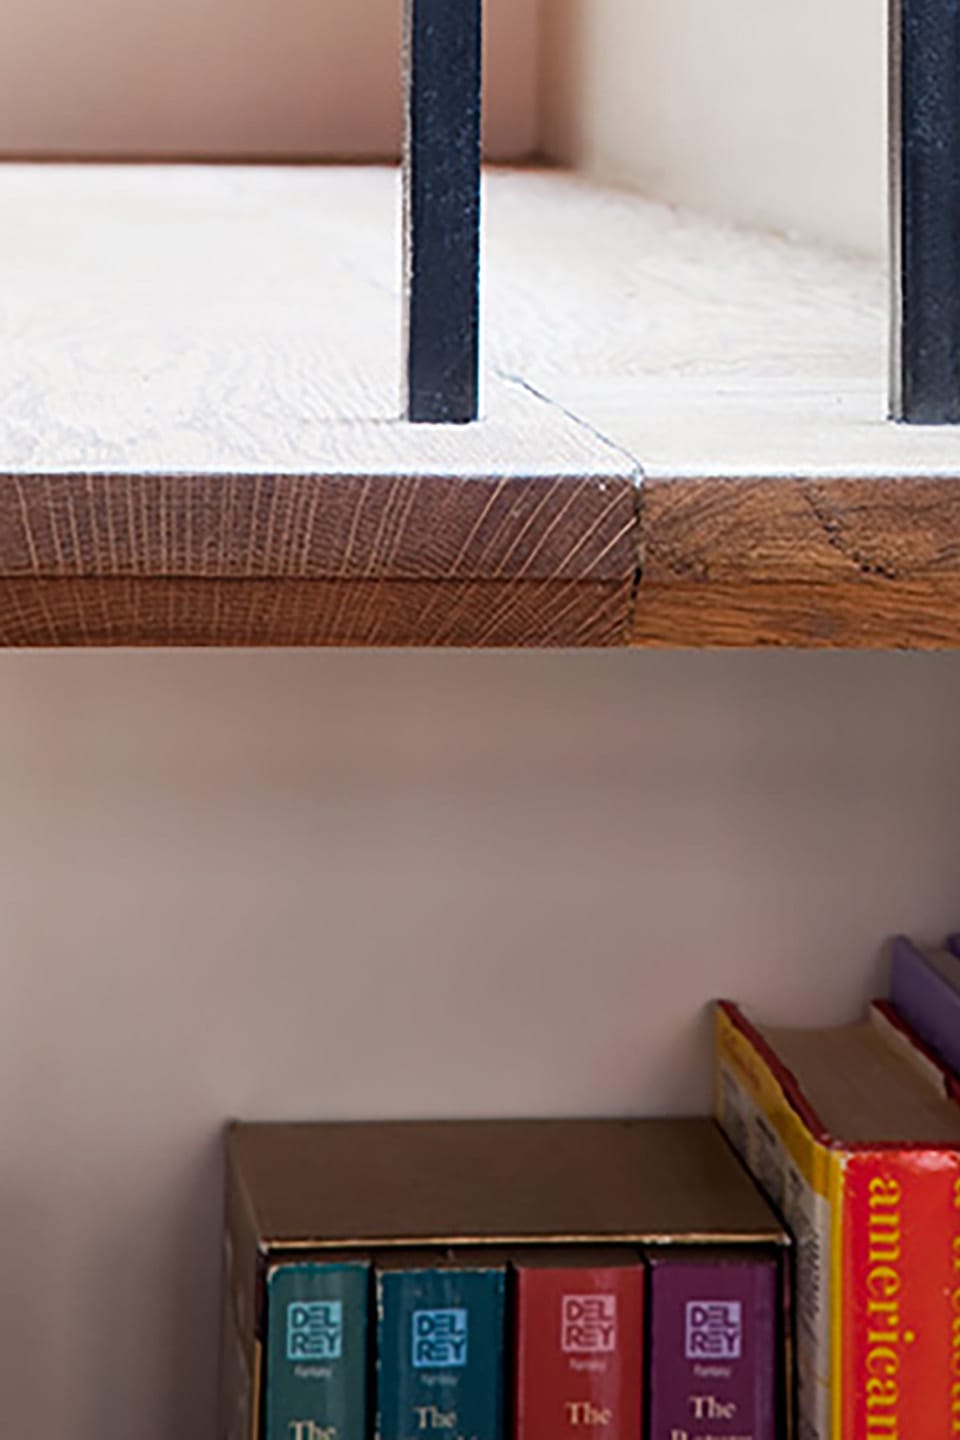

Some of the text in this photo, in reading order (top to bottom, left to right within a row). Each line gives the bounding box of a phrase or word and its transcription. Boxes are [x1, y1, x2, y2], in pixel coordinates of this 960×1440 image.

[291, 1306, 338, 1329] DEL
[566, 1299, 613, 1322] DEL
[690, 1305, 738, 1328] DEL
[417, 1314, 465, 1336] DEL
[566, 1325, 614, 1347] REY
[291, 1331, 338, 1354] REY
[417, 1339, 465, 1361] REY
[690, 1330, 738, 1353] REY
[413, 1406, 457, 1429] The
[566, 1402, 611, 1425] The
[689, 1396, 736, 1419] The
[289, 1421, 336, 1440] The
